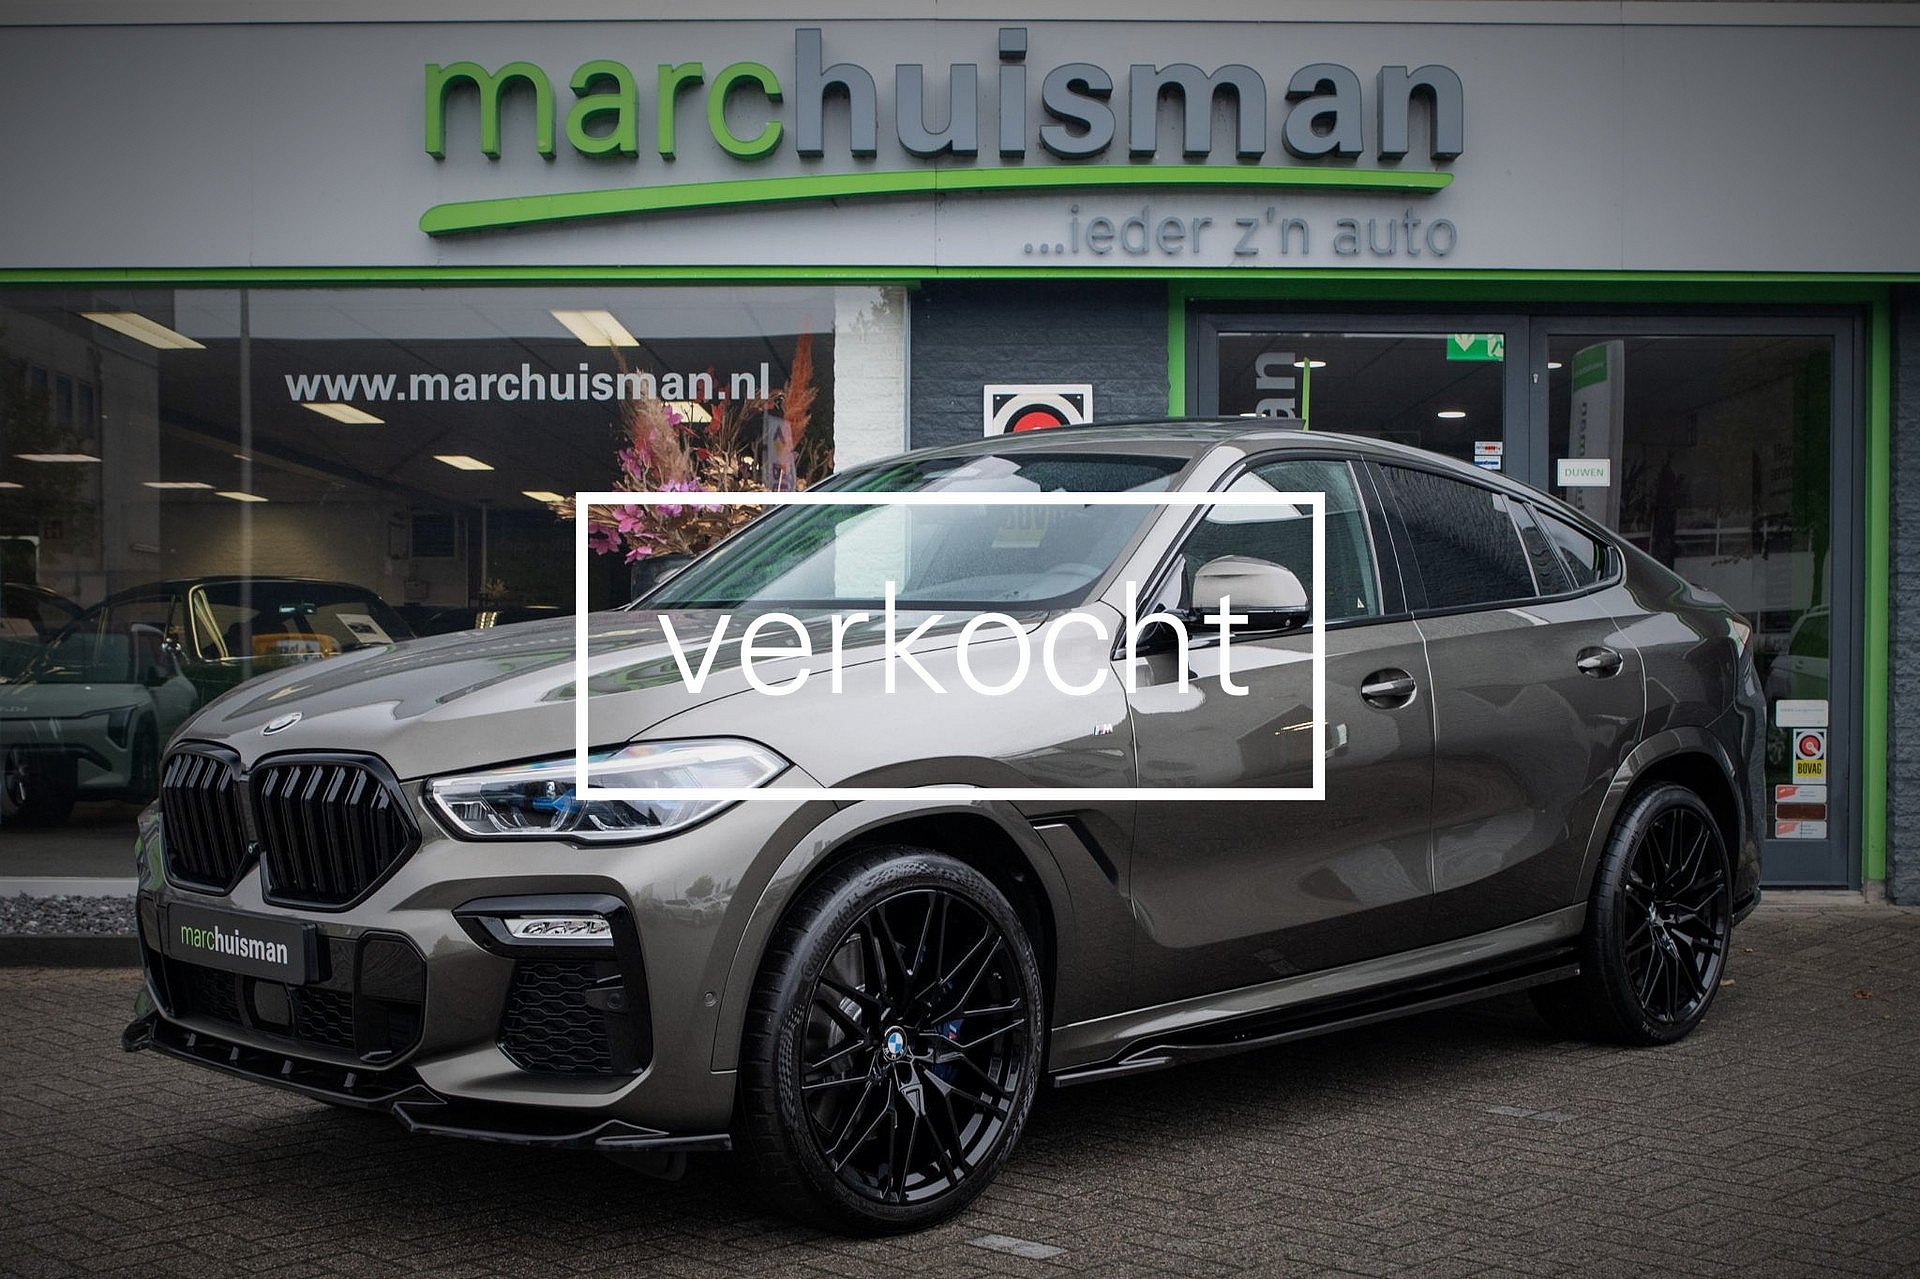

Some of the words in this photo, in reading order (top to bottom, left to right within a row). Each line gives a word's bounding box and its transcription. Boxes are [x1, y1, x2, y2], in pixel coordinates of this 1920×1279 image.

[425, 28, 1464, 160] marchuisman
[1233, 206, 1310, 256] z'n
[1333, 206, 1458, 257] auto
[285, 362, 770, 401] www.marchuisman.nl
[1564, 468, 1604, 477] DUWEN
[1797, 762, 1822, 775] BOVAG
[180, 925, 288, 964] marchuisman
